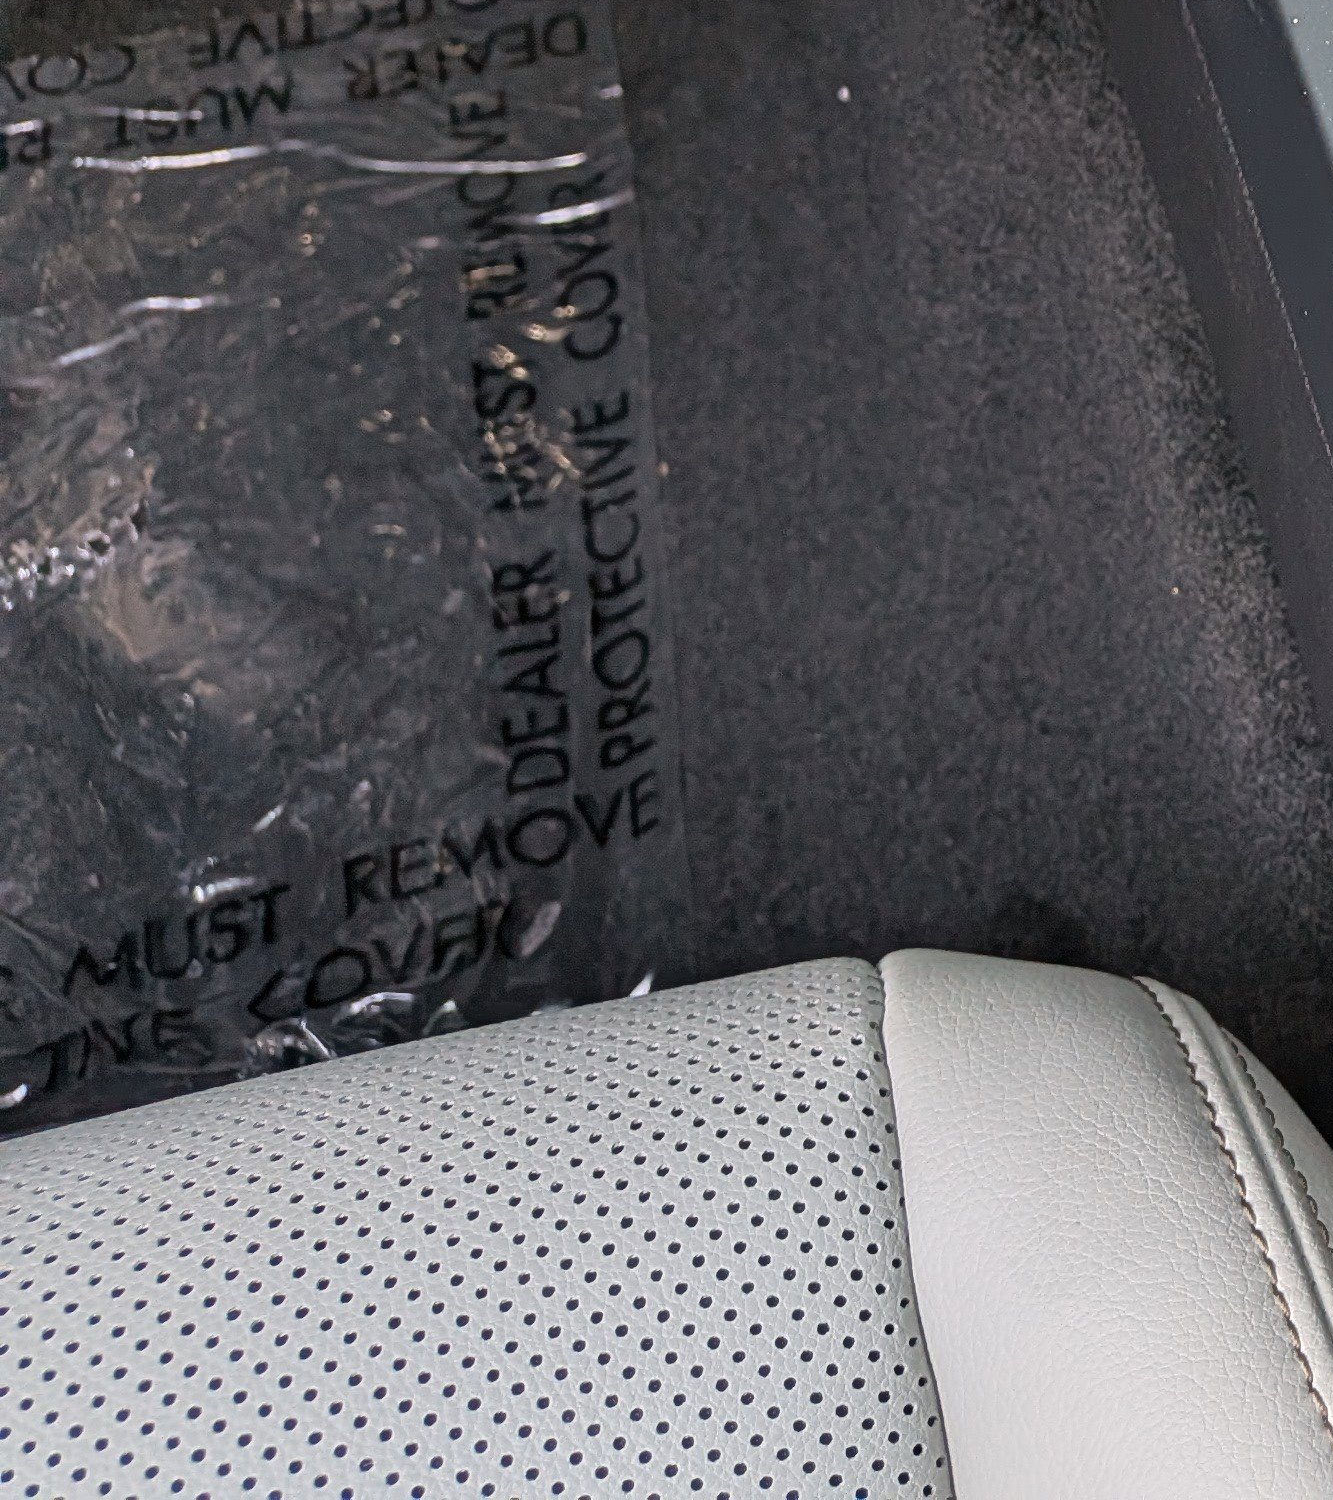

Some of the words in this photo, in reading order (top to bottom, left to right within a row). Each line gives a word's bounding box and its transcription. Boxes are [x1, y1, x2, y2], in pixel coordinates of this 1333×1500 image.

[549, 171, 622, 361] COVER
[490, 550, 570, 796] DEALER
[571, 390, 655, 770] PROTECTIVE
[62, 883, 291, 997] MUST
[341, 768, 662, 918] REMOVE
